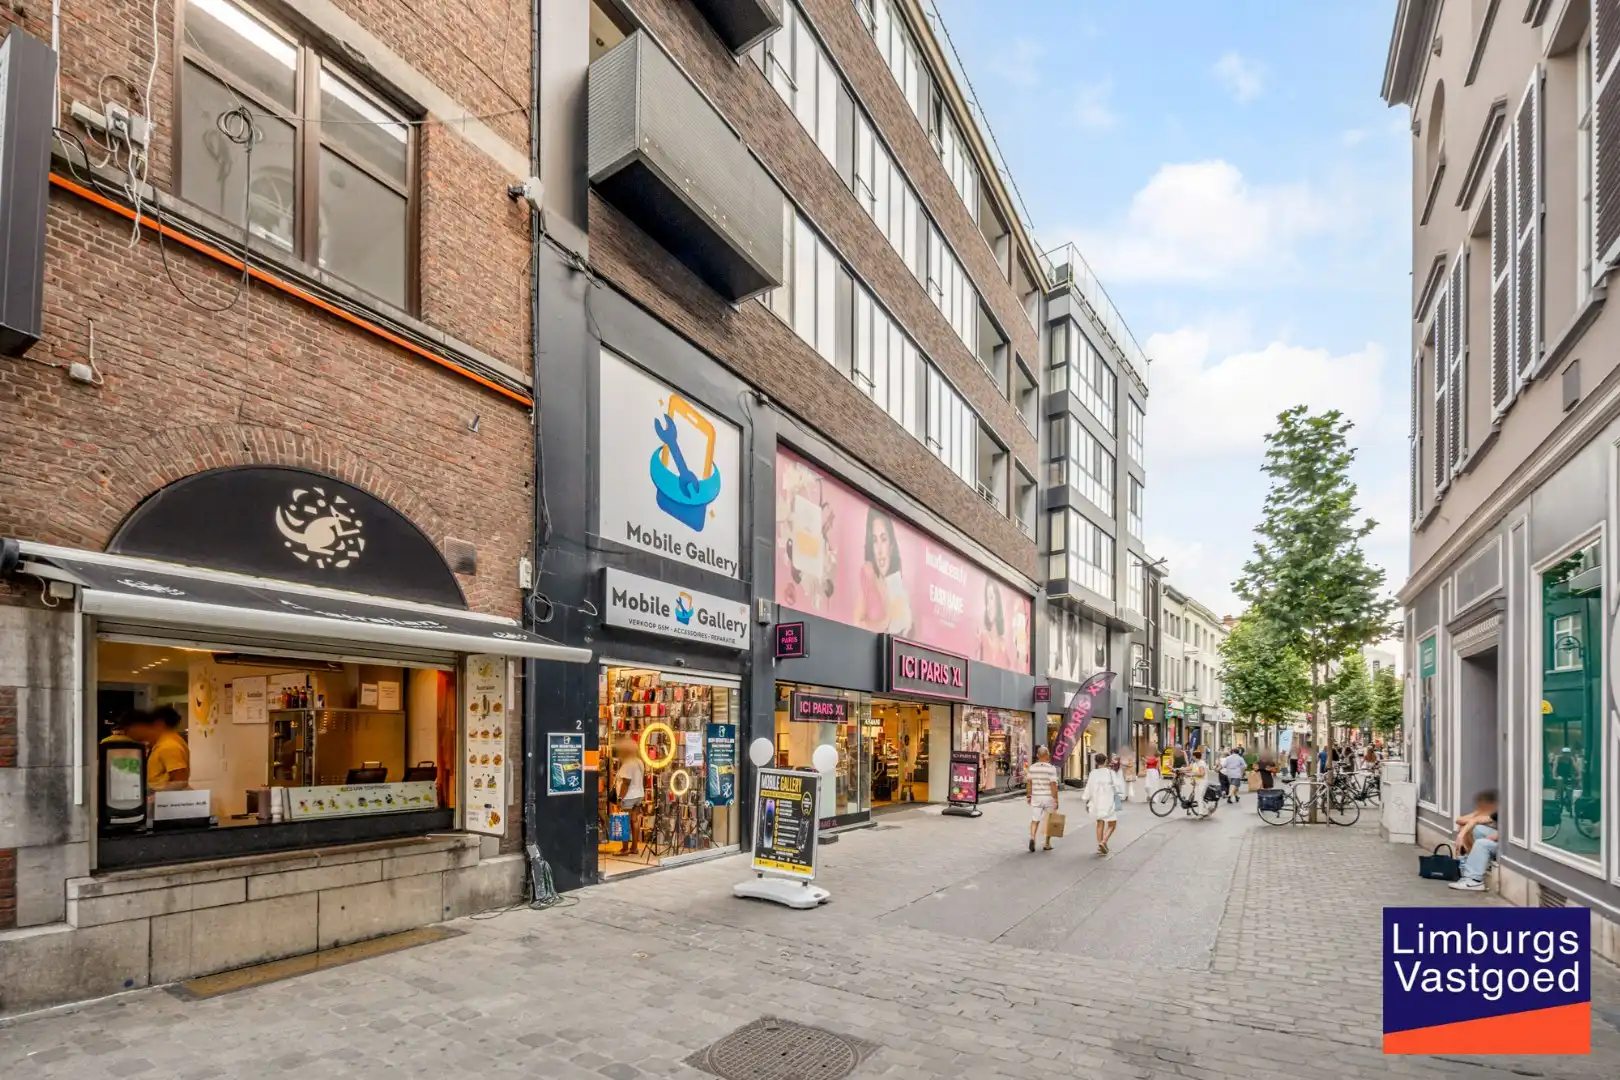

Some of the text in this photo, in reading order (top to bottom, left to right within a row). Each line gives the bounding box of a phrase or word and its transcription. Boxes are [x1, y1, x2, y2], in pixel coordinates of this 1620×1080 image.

[627, 521, 738, 577] Mobile Gallery
[612, 586, 747, 638] Mobile Gallery
[628, 618, 657, 629] VERKOOP
[673, 627, 708, 639] ACCESSOIRES
[710, 635, 736, 645] REPARATIE
[781, 636, 798, 644] PARIS
[900, 655, 963, 687] ICI PARIS XL
[800, 701, 844, 716] ICI PARIS XL
[576, 720, 582, 730] 2
[1053, 740, 1069, 760] ICI
[1063, 699, 1091, 739] PARIS
[761, 774, 803, 793] MOBILE GALLERY
[953, 775, 974, 783] SALE
